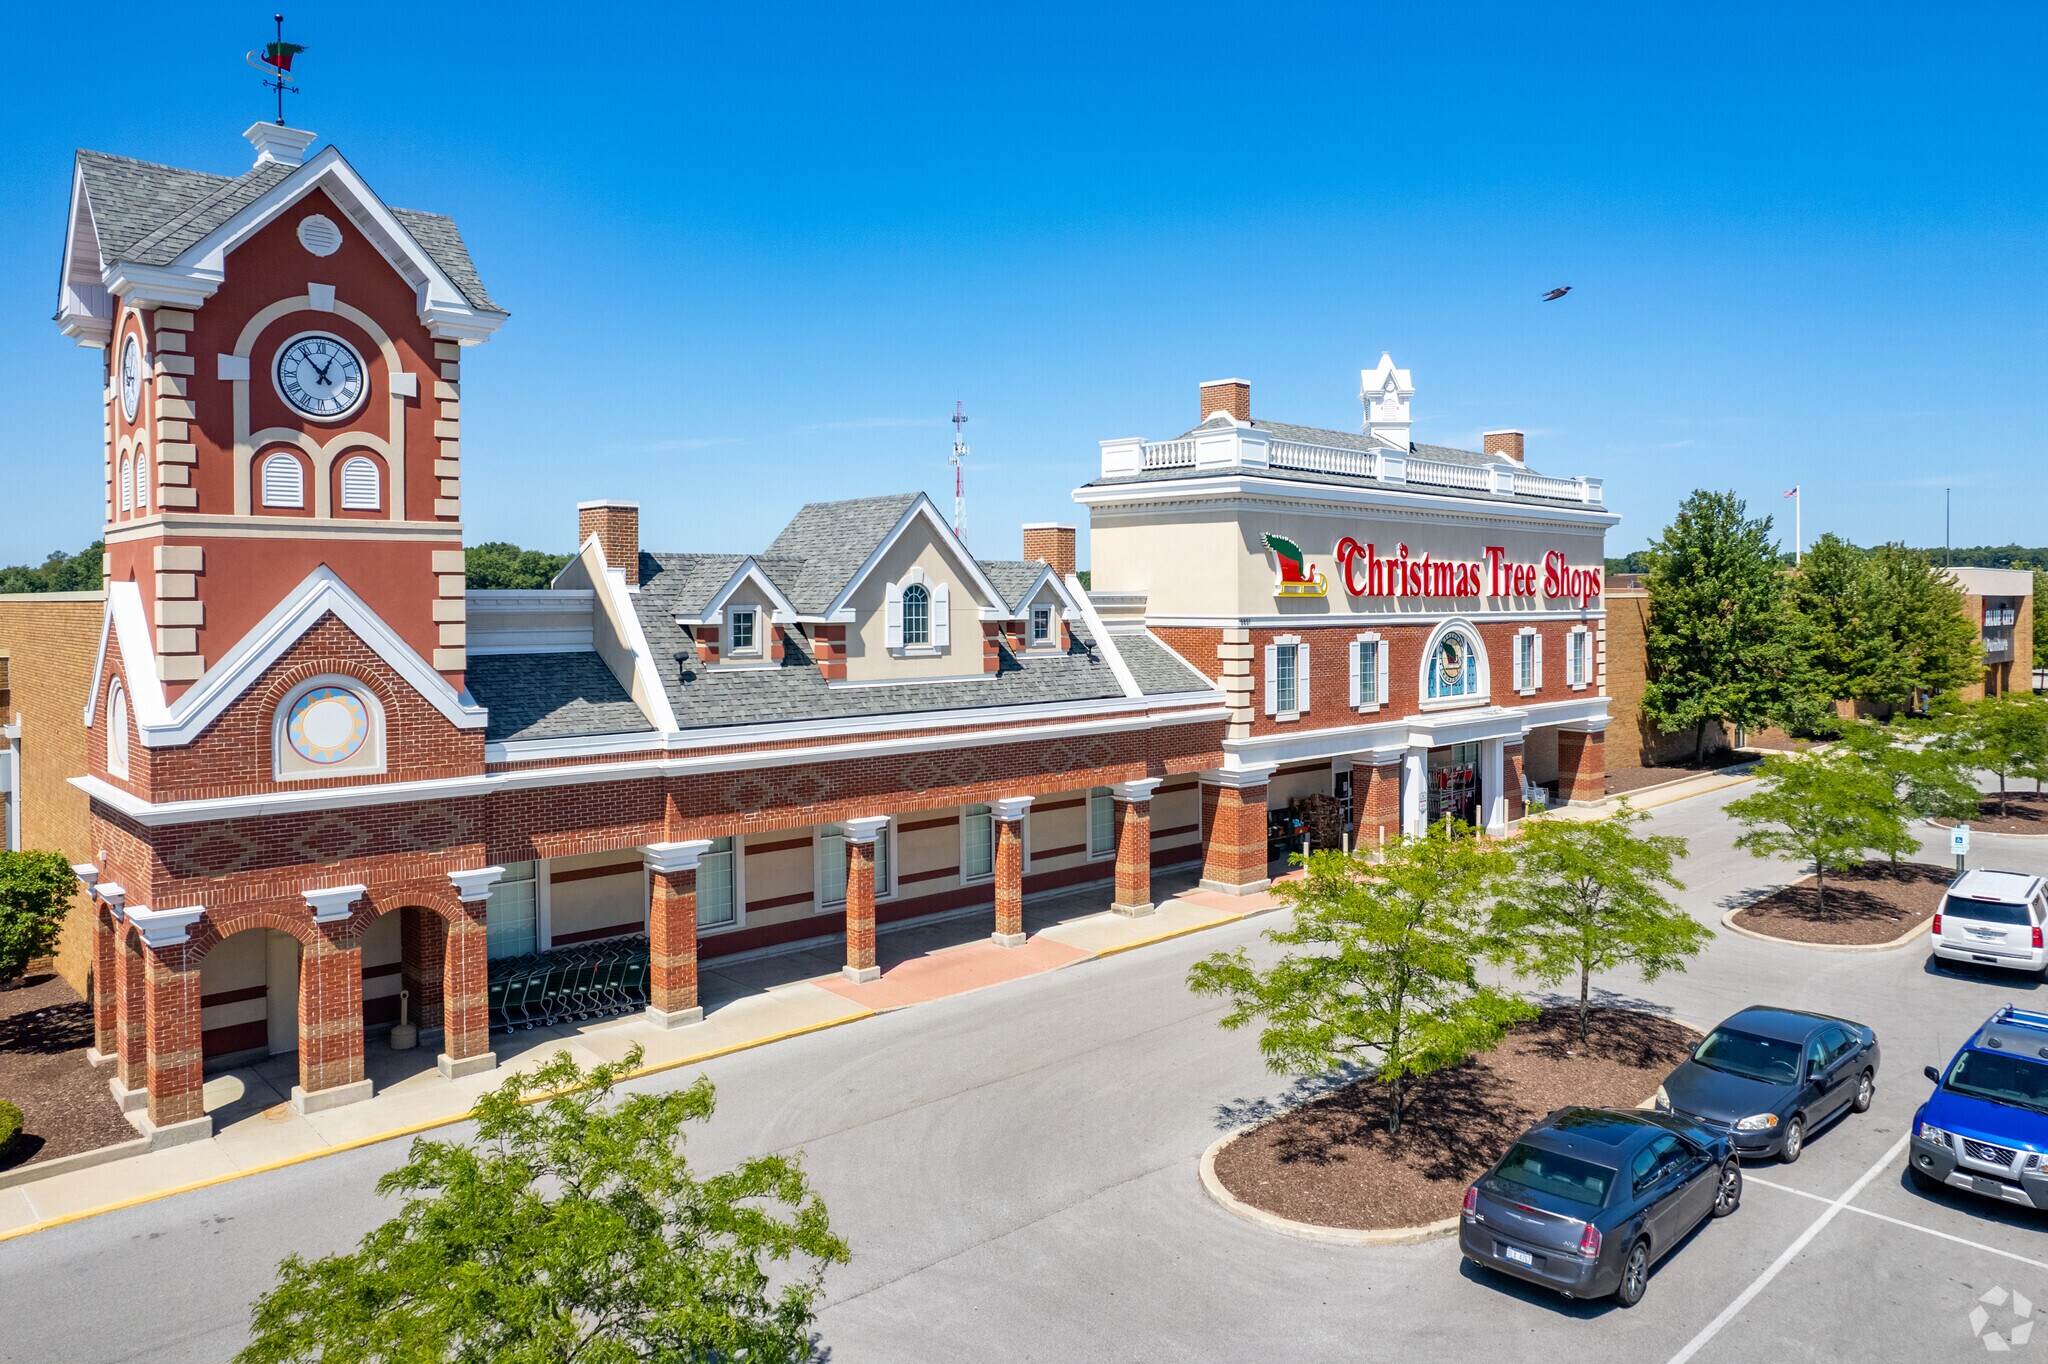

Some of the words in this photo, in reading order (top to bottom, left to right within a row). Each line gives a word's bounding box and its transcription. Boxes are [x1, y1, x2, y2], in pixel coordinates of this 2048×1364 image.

[316, 343, 327, 354] XII
[287, 354, 301, 366] X
[342, 361, 353, 369] II
[284, 369, 297, 378] IX
[317, 399, 326, 411] VI
[333, 397, 342, 409] V
[1335, 536, 1481, 598] Christmas
[1483, 546, 1537, 598] Tree
[1542, 549, 1601, 608] Shops
